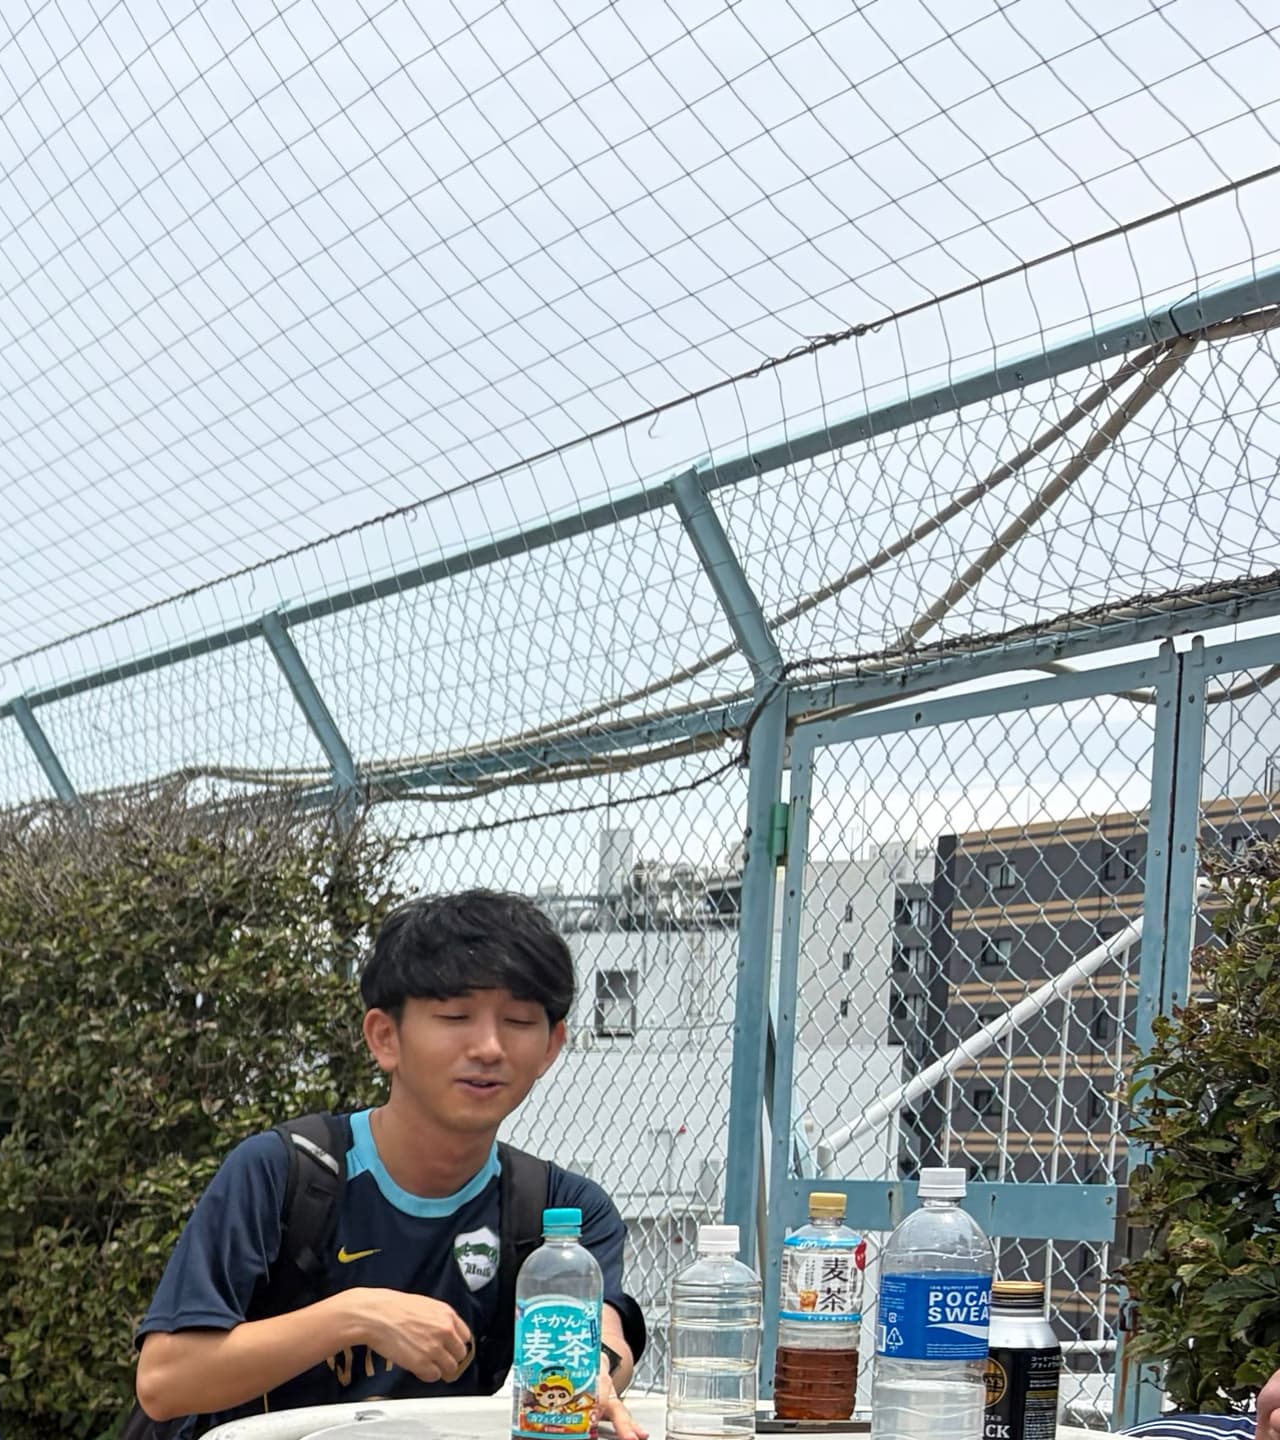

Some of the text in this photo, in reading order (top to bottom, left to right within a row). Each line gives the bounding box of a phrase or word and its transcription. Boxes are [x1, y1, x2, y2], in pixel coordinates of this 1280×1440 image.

[818, 1257, 849, 1312] 麦茶
[928, 1291, 992, 1306] POCA
[927, 1307, 989, 1322] SWEA
[522, 1329, 594, 1368] 麦茶
